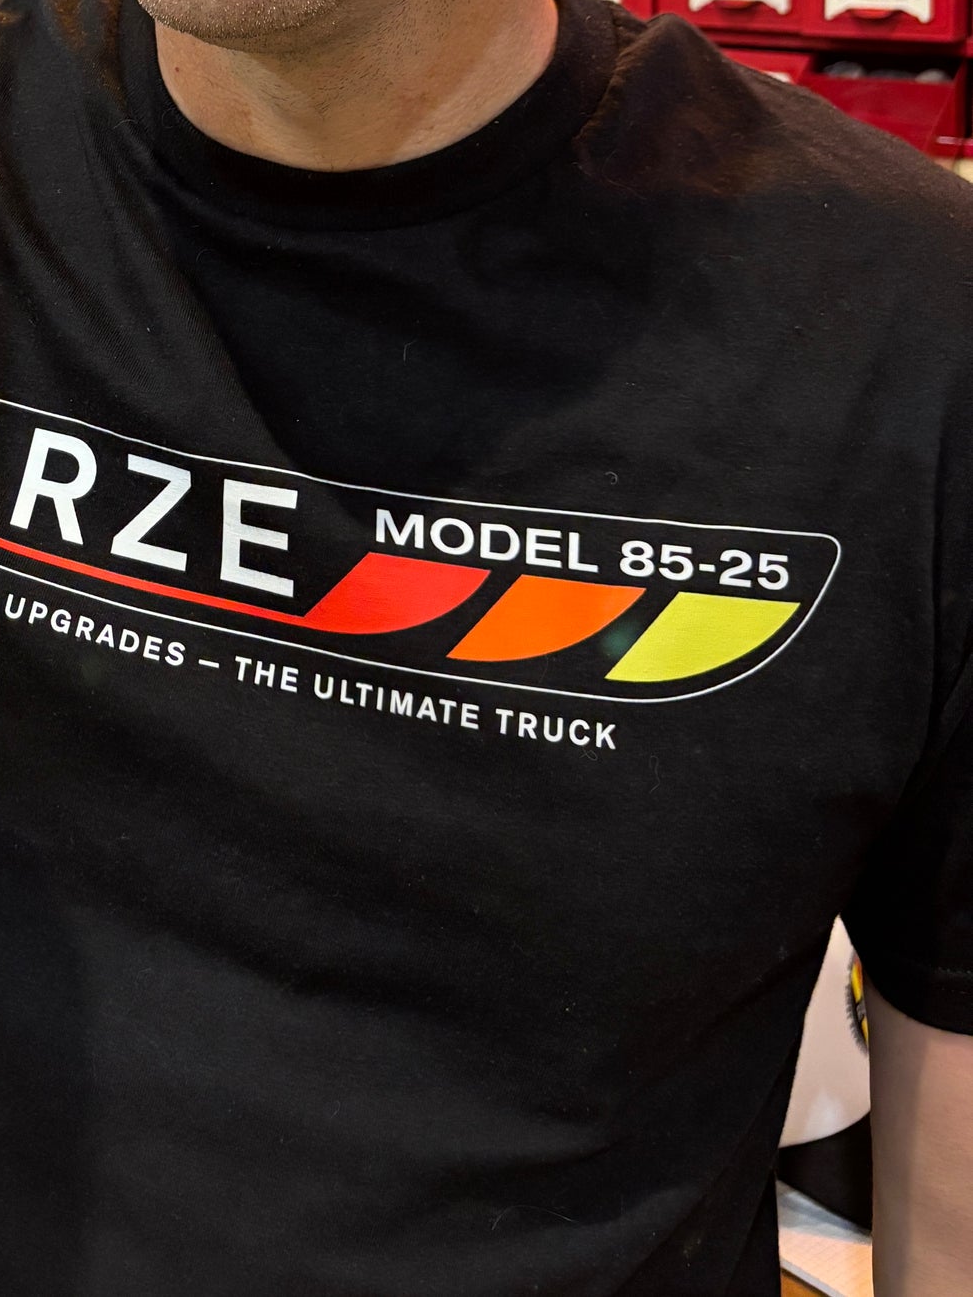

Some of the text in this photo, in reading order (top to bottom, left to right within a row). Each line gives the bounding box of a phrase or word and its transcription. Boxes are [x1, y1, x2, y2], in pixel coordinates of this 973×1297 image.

[375, 508, 789, 591] MODEL 85-25
[4, 593, 186, 667] UPGRADES
[234, 655, 299, 693] THE
[313, 673, 480, 730] ULTIMATE
[495, 708, 616, 750] TRUCK
